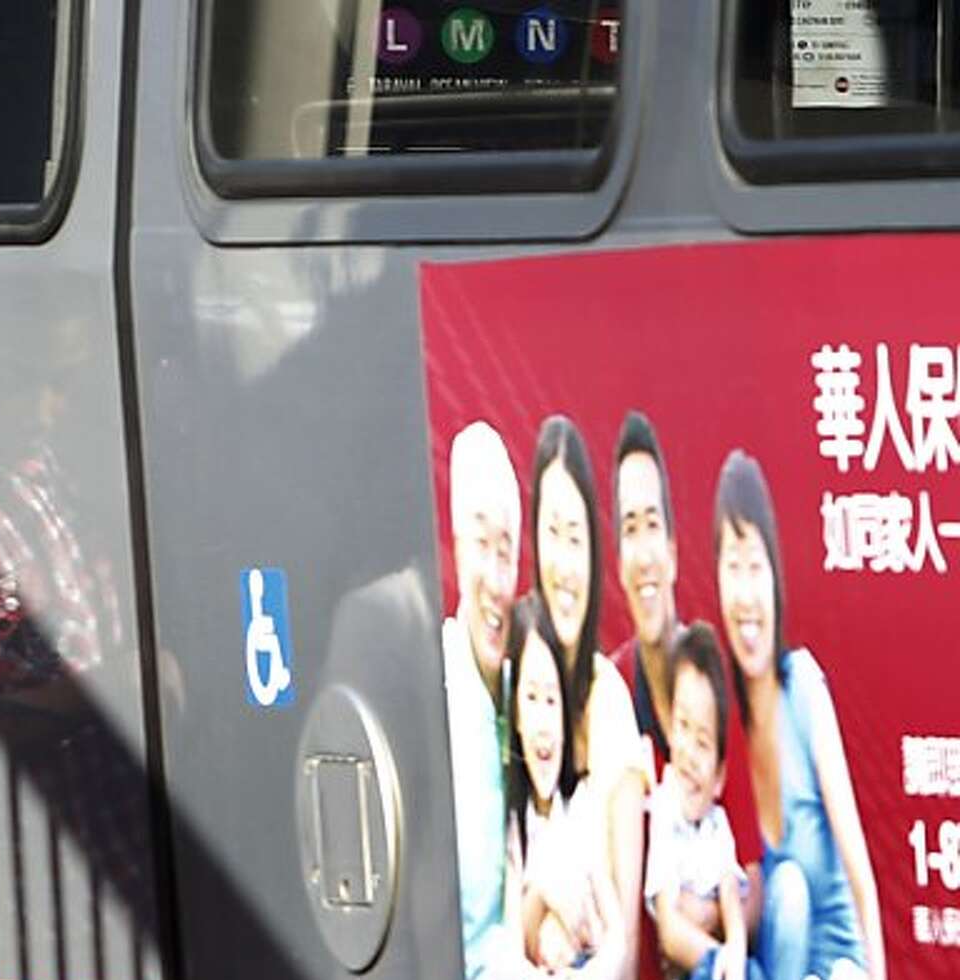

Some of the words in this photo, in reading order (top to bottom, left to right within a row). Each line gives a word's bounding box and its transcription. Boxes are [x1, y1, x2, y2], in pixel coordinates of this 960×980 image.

[386, 19, 408, 50] L
[450, 19, 485, 50] M
[528, 19, 556, 50] N
[811, 342, 960, 472] 華人保
[908, 820, 960, 890] 1-8
